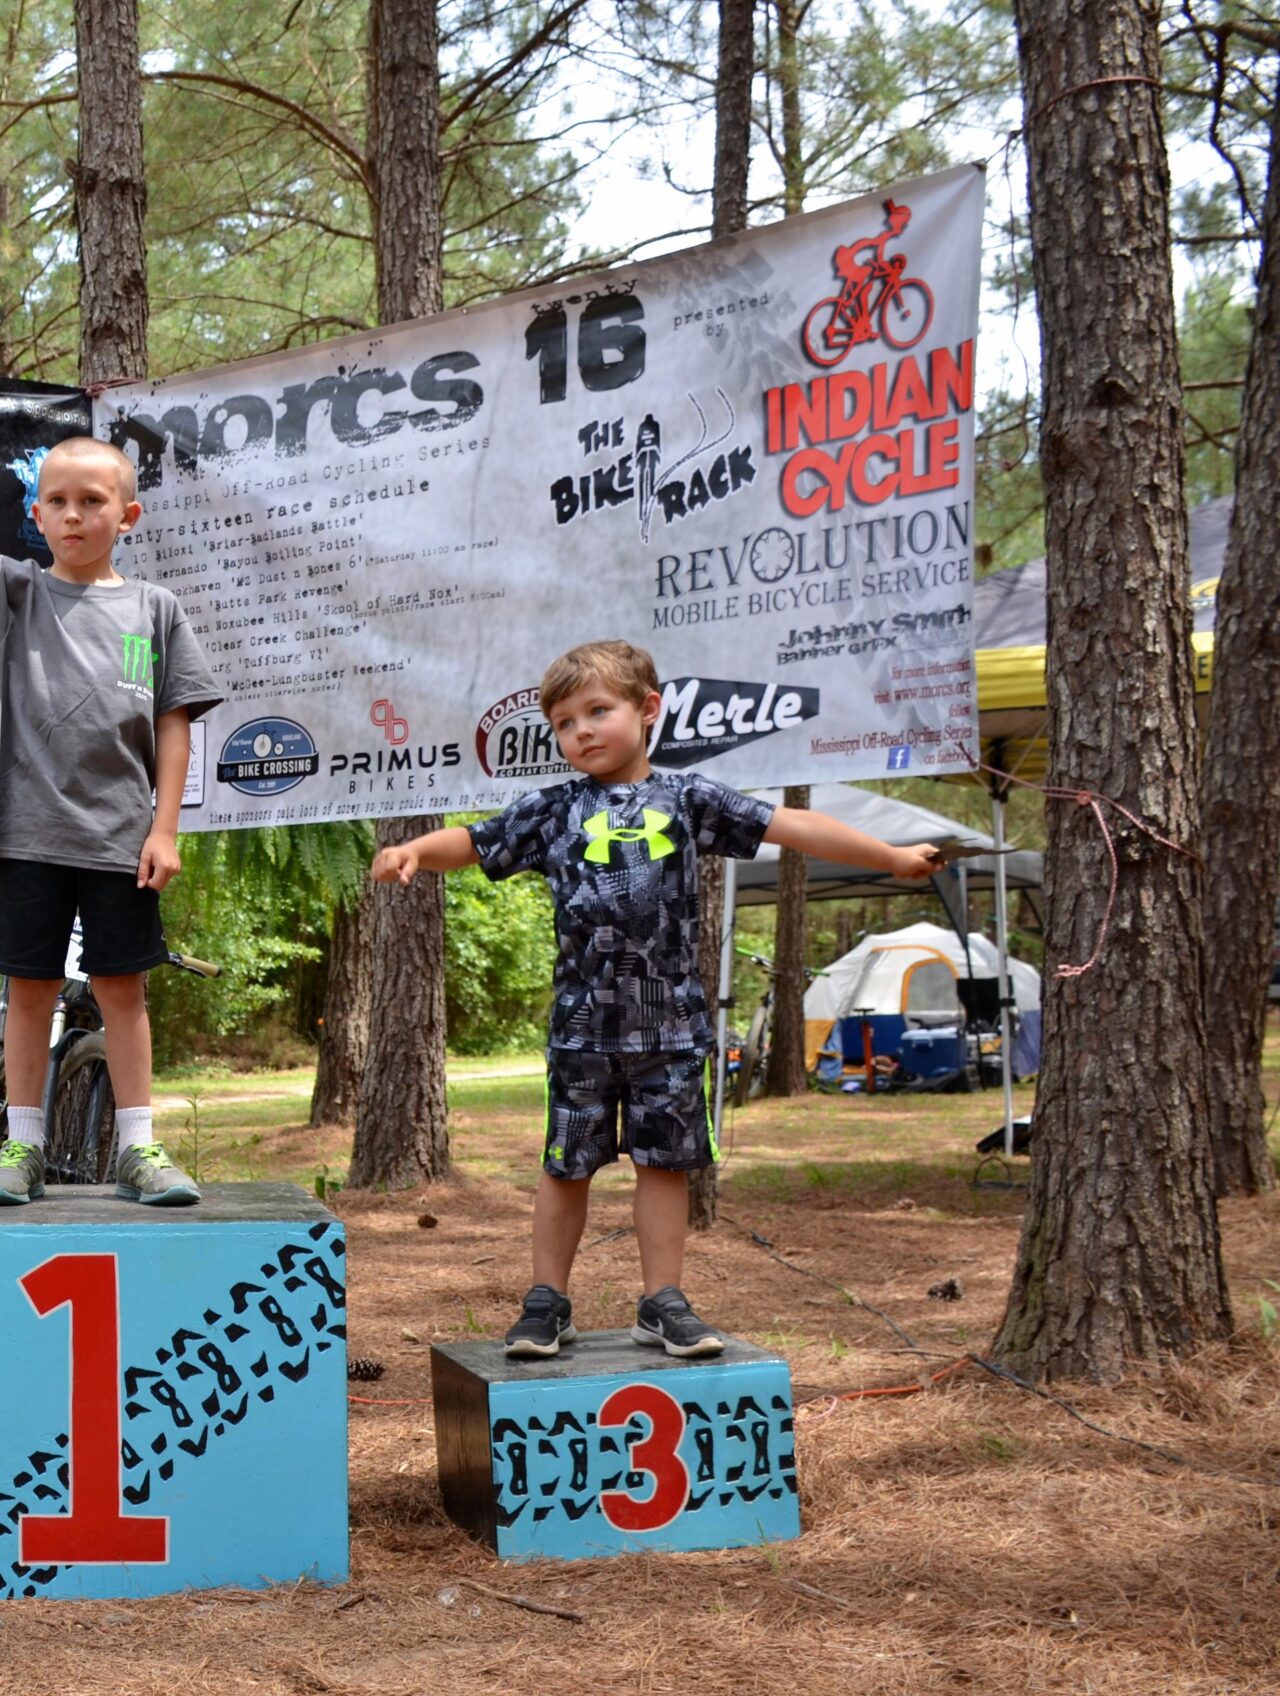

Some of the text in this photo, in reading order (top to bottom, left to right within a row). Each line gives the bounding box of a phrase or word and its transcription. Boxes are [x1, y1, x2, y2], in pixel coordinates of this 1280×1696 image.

[530, 277, 638, 317] twenty
[672, 292, 769, 332] presented
[524, 293, 647, 405] 16
[706, 321, 726, 338] by
[762, 338, 975, 454] INDIAN
[109, 350, 484, 492] morcs
[577, 416, 625, 457] THE
[221, 436, 490, 499] Off-Road Cycling Series
[550, 443, 758, 526] BIKE RACK
[780, 418, 960, 518] CYCLE
[266, 478, 430, 520] race schedule
[155, 544, 194, 563] Biloxi
[311, 512, 363, 534] Battle'
[156, 533, 362, 581] Hernando 'Bayou Boiling Point'
[655, 500, 970, 598] REVOLUTION
[258, 570, 287, 585] Dust
[293, 569, 301, 579] n
[307, 561, 341, 578] Bones
[652, 557, 970, 629] MOBILE BICYCLE SERVICE
[209, 597, 250, 612] 'Butts
[258, 591, 287, 605] Park
[294, 579, 348, 600] Revenge'
[215, 616, 265, 631] Noxubee
[273, 608, 308, 624] Hills
[318, 600, 359, 616] 'Skool
[367, 596, 381, 611] of
[389, 591, 421, 607] Hard
[429, 584, 458, 600] Nox'
[205, 621, 367, 653] 'Clear Creek Challenge'
[894, 681, 971, 702] www.morcs.org
[646, 678, 803, 757] Merle
[329, 743, 461, 777] PRIMUS
[661, 735, 739, 751] COMPOSITES REPAIR
[810, 724, 973, 755] Mississippi Off-Road Cycling Series
[924, 754, 936, 764] on
[238, 763, 260, 778] BIKE
[263, 758, 312, 775] CROSSING
[348, 773, 435, 794] BIKES
[515, 767, 539, 777] PLAY
[209, 811, 232, 825] these
[235, 808, 273, 826] sponsors
[275, 806, 295, 823] paid
[299, 803, 319, 818] lots
[322, 802, 333, 816] of
[17, 1252, 170, 1566] 1
[597, 1382, 690, 1533] 3
